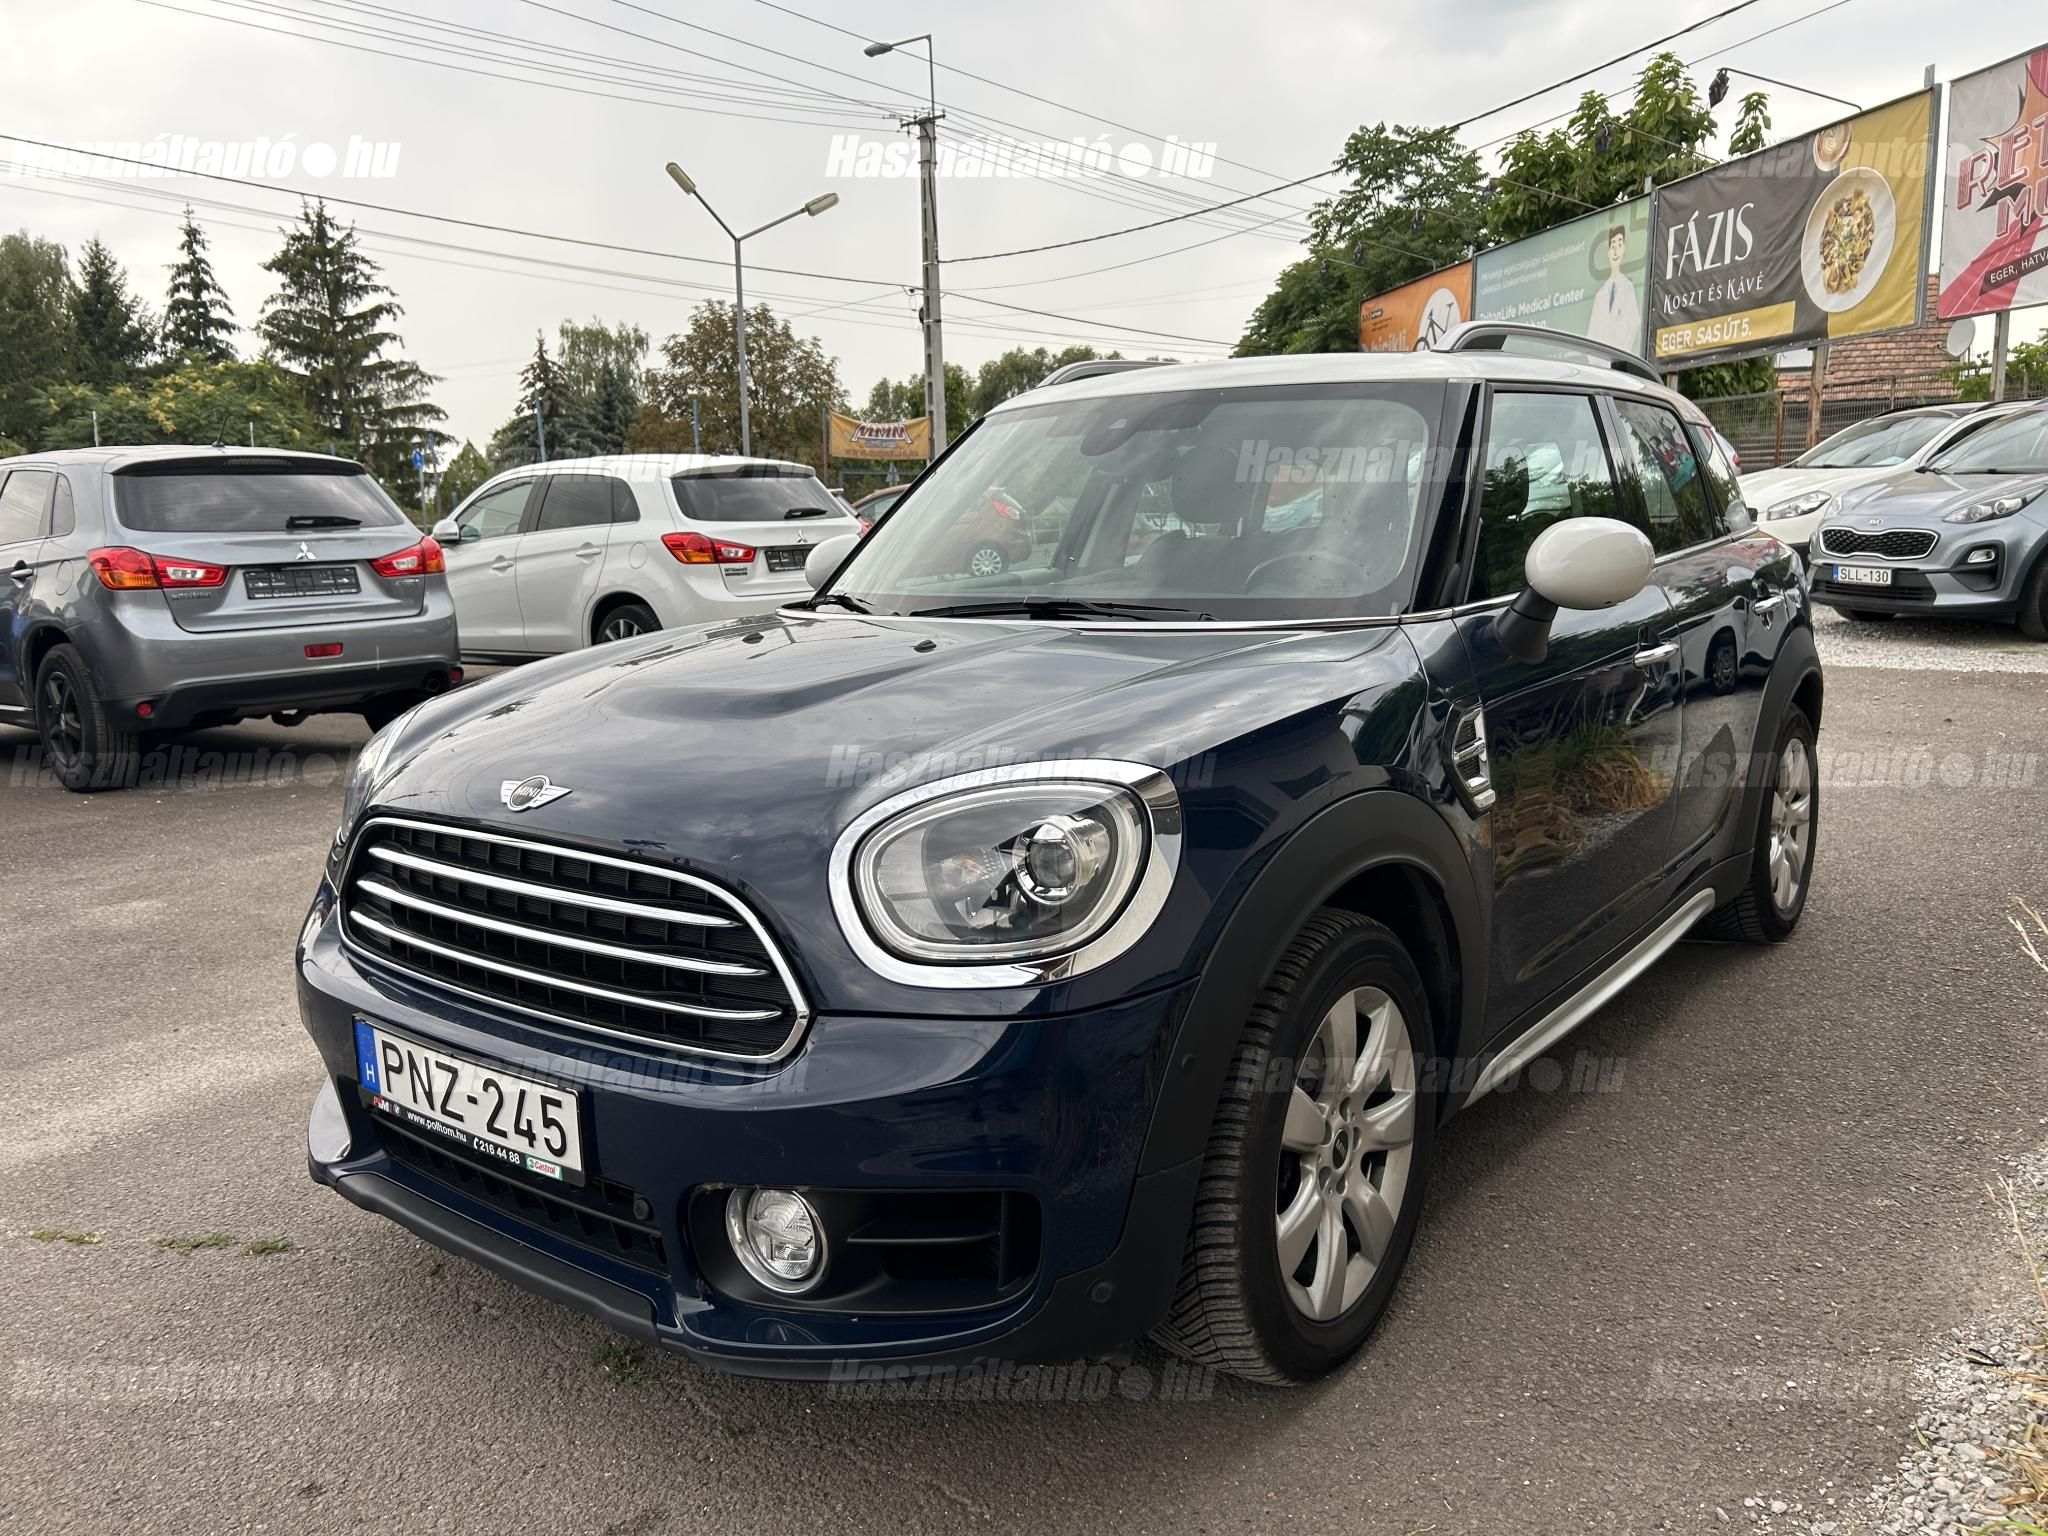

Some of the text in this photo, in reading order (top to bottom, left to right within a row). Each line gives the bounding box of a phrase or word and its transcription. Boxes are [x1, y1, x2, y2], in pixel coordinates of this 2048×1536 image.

[1665, 203, 1754, 280] FÁZIS
[1990, 251, 2048, 284] EGER, HATV
[1518, 294, 1551, 316] Medical
[1553, 288, 1585, 307] Center
[1708, 283, 1722, 301] ÉS
[1696, 323, 1722, 345] SAS
[1723, 316, 1742, 340] ÚT
[1840, 571, 1889, 584] SLL-130
[365, 1062, 376, 1084] H
[381, 1040, 567, 1158] PNZ-245
[480, 1140, 520, 1164] 216 44 88
[535, 1161, 556, 1176] Castrol
